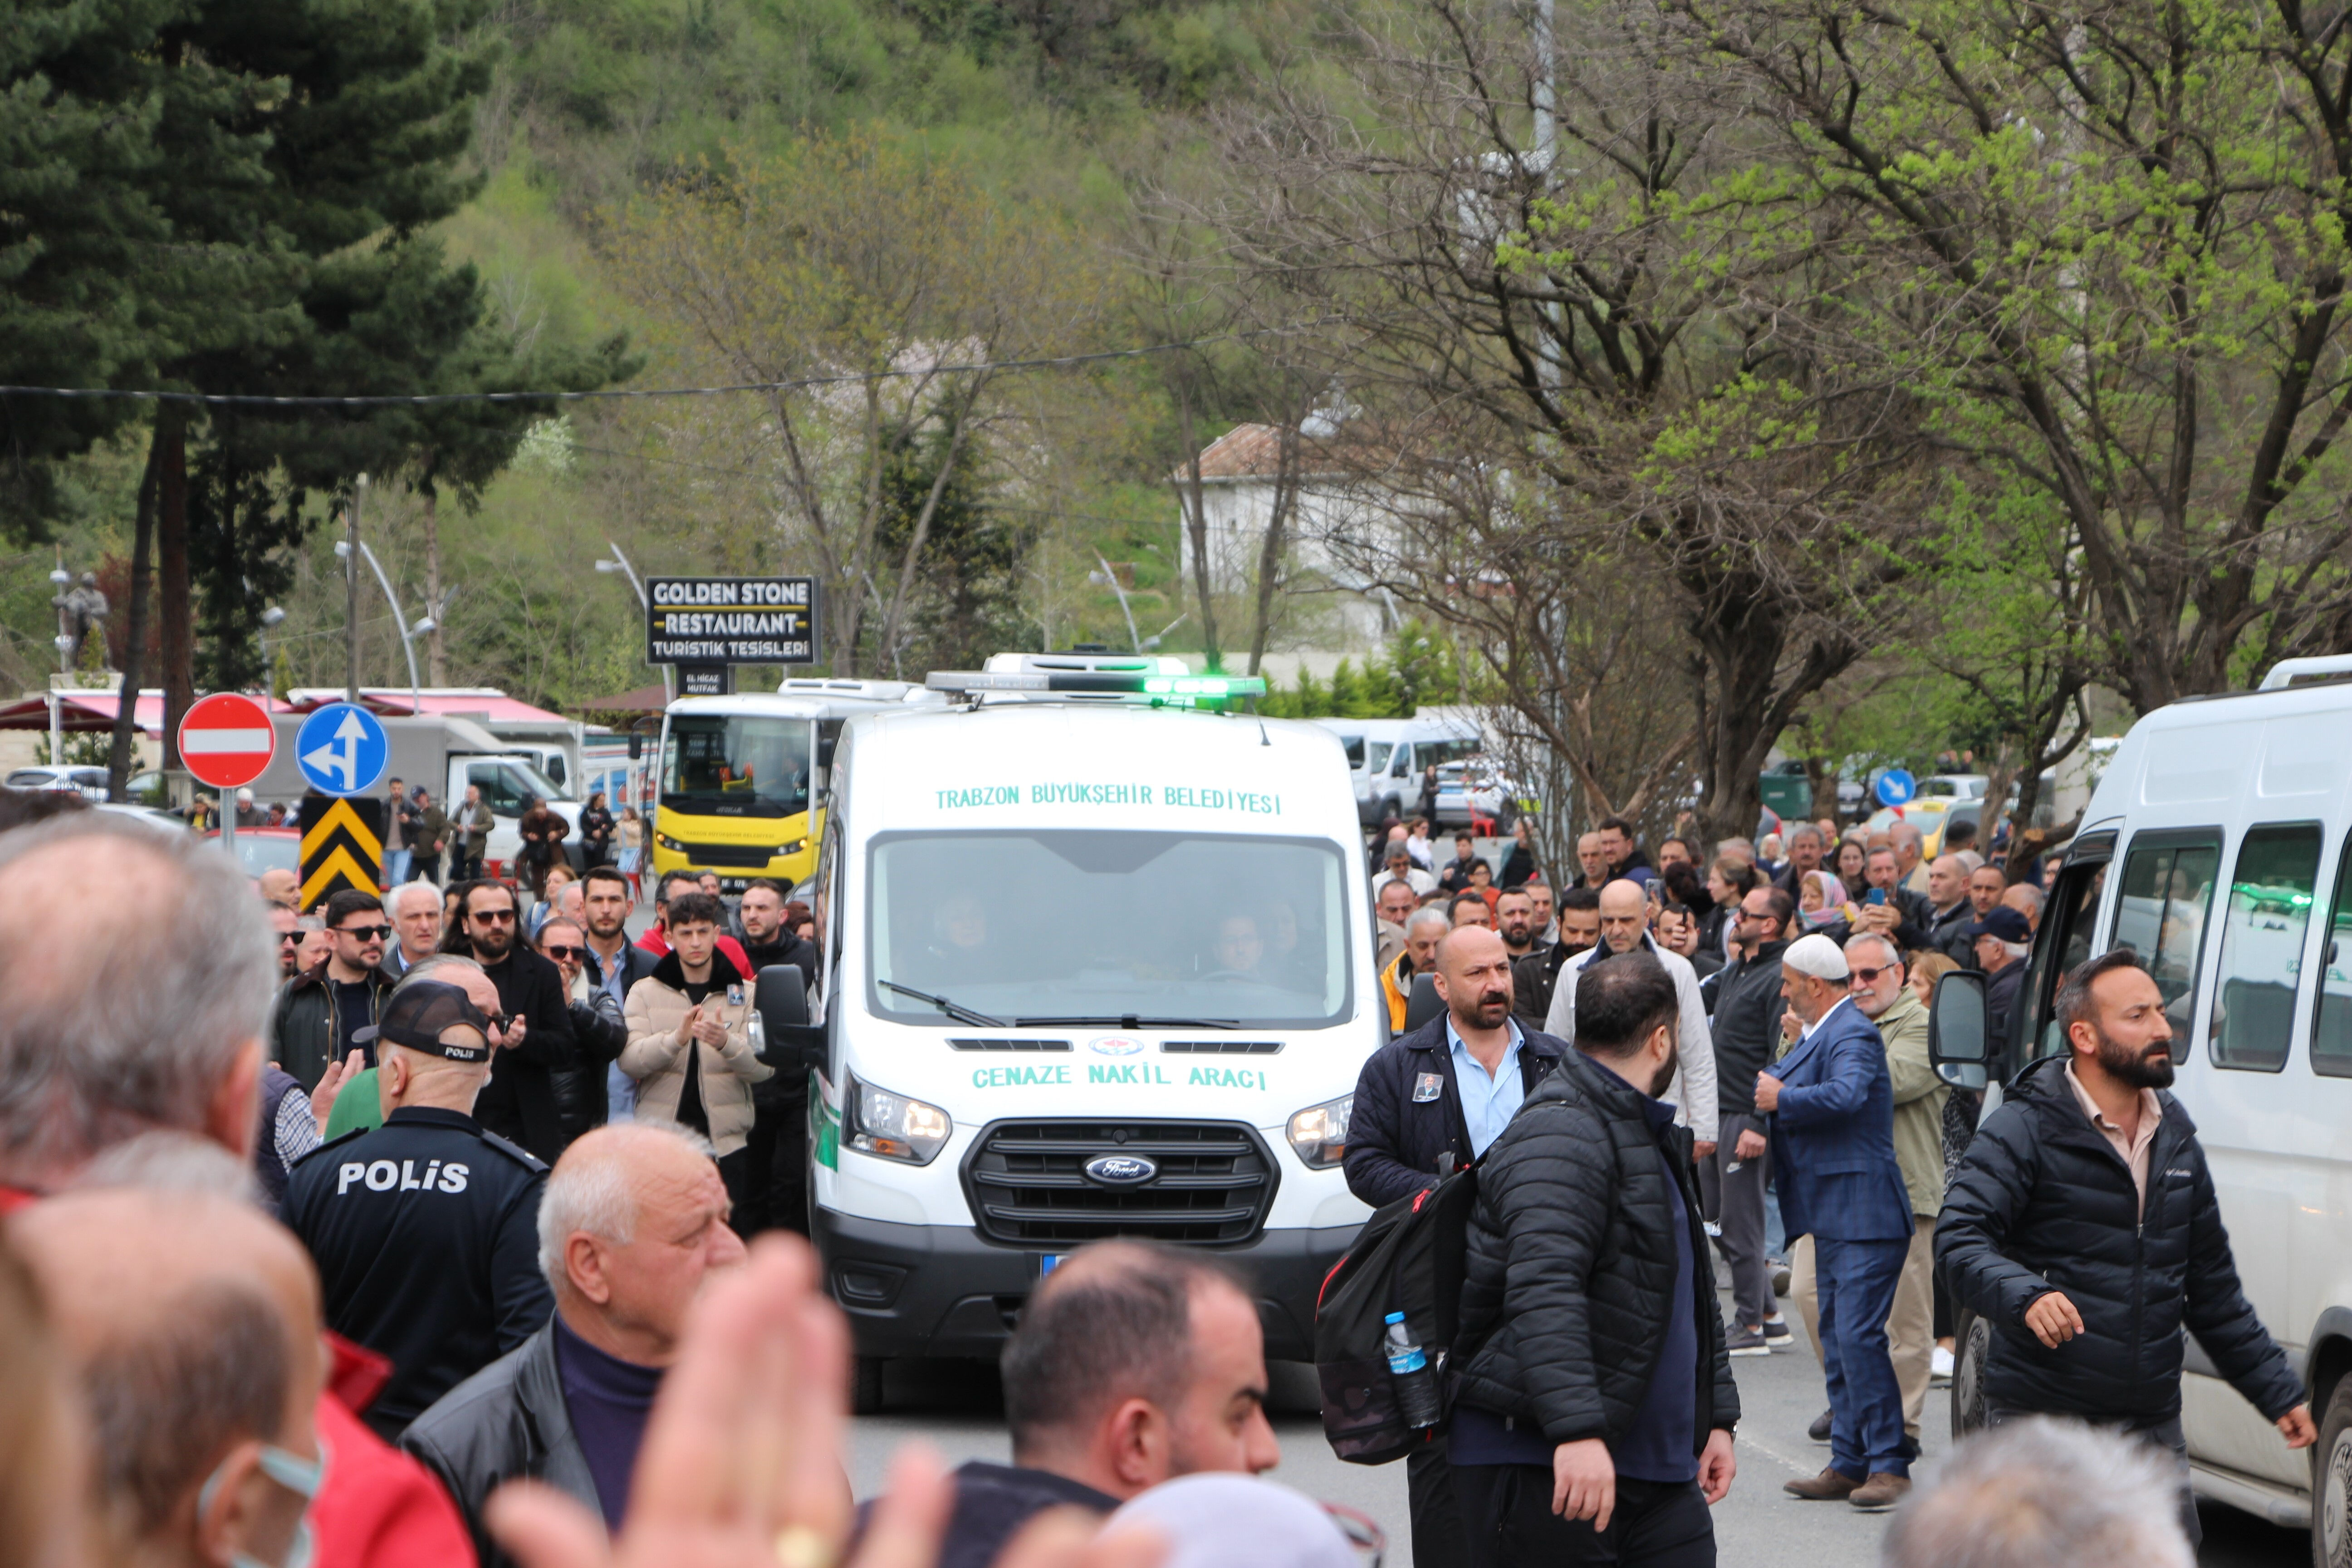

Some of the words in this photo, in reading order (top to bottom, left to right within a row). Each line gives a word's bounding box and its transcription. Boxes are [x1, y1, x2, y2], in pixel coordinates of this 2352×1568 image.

[654, 583, 737, 604] GOLDEN
[741, 583, 808, 604] STONE
[665, 613, 797, 635] RESTAURANT
[686, 674, 696, 682] EL
[687, 684, 718, 693] MUTFAK
[936, 785, 1019, 809] TRABZON
[1031, 782, 1152, 806] BÜYÜKŞEHİR
[1164, 786, 1280, 815] BELEDİYESİ
[972, 1065, 1072, 1088] CENAZE
[1088, 1062, 1171, 1084] NAKİL
[1188, 1067, 1266, 1091] ARACI
[1102, 1160, 1140, 1177] Ford
